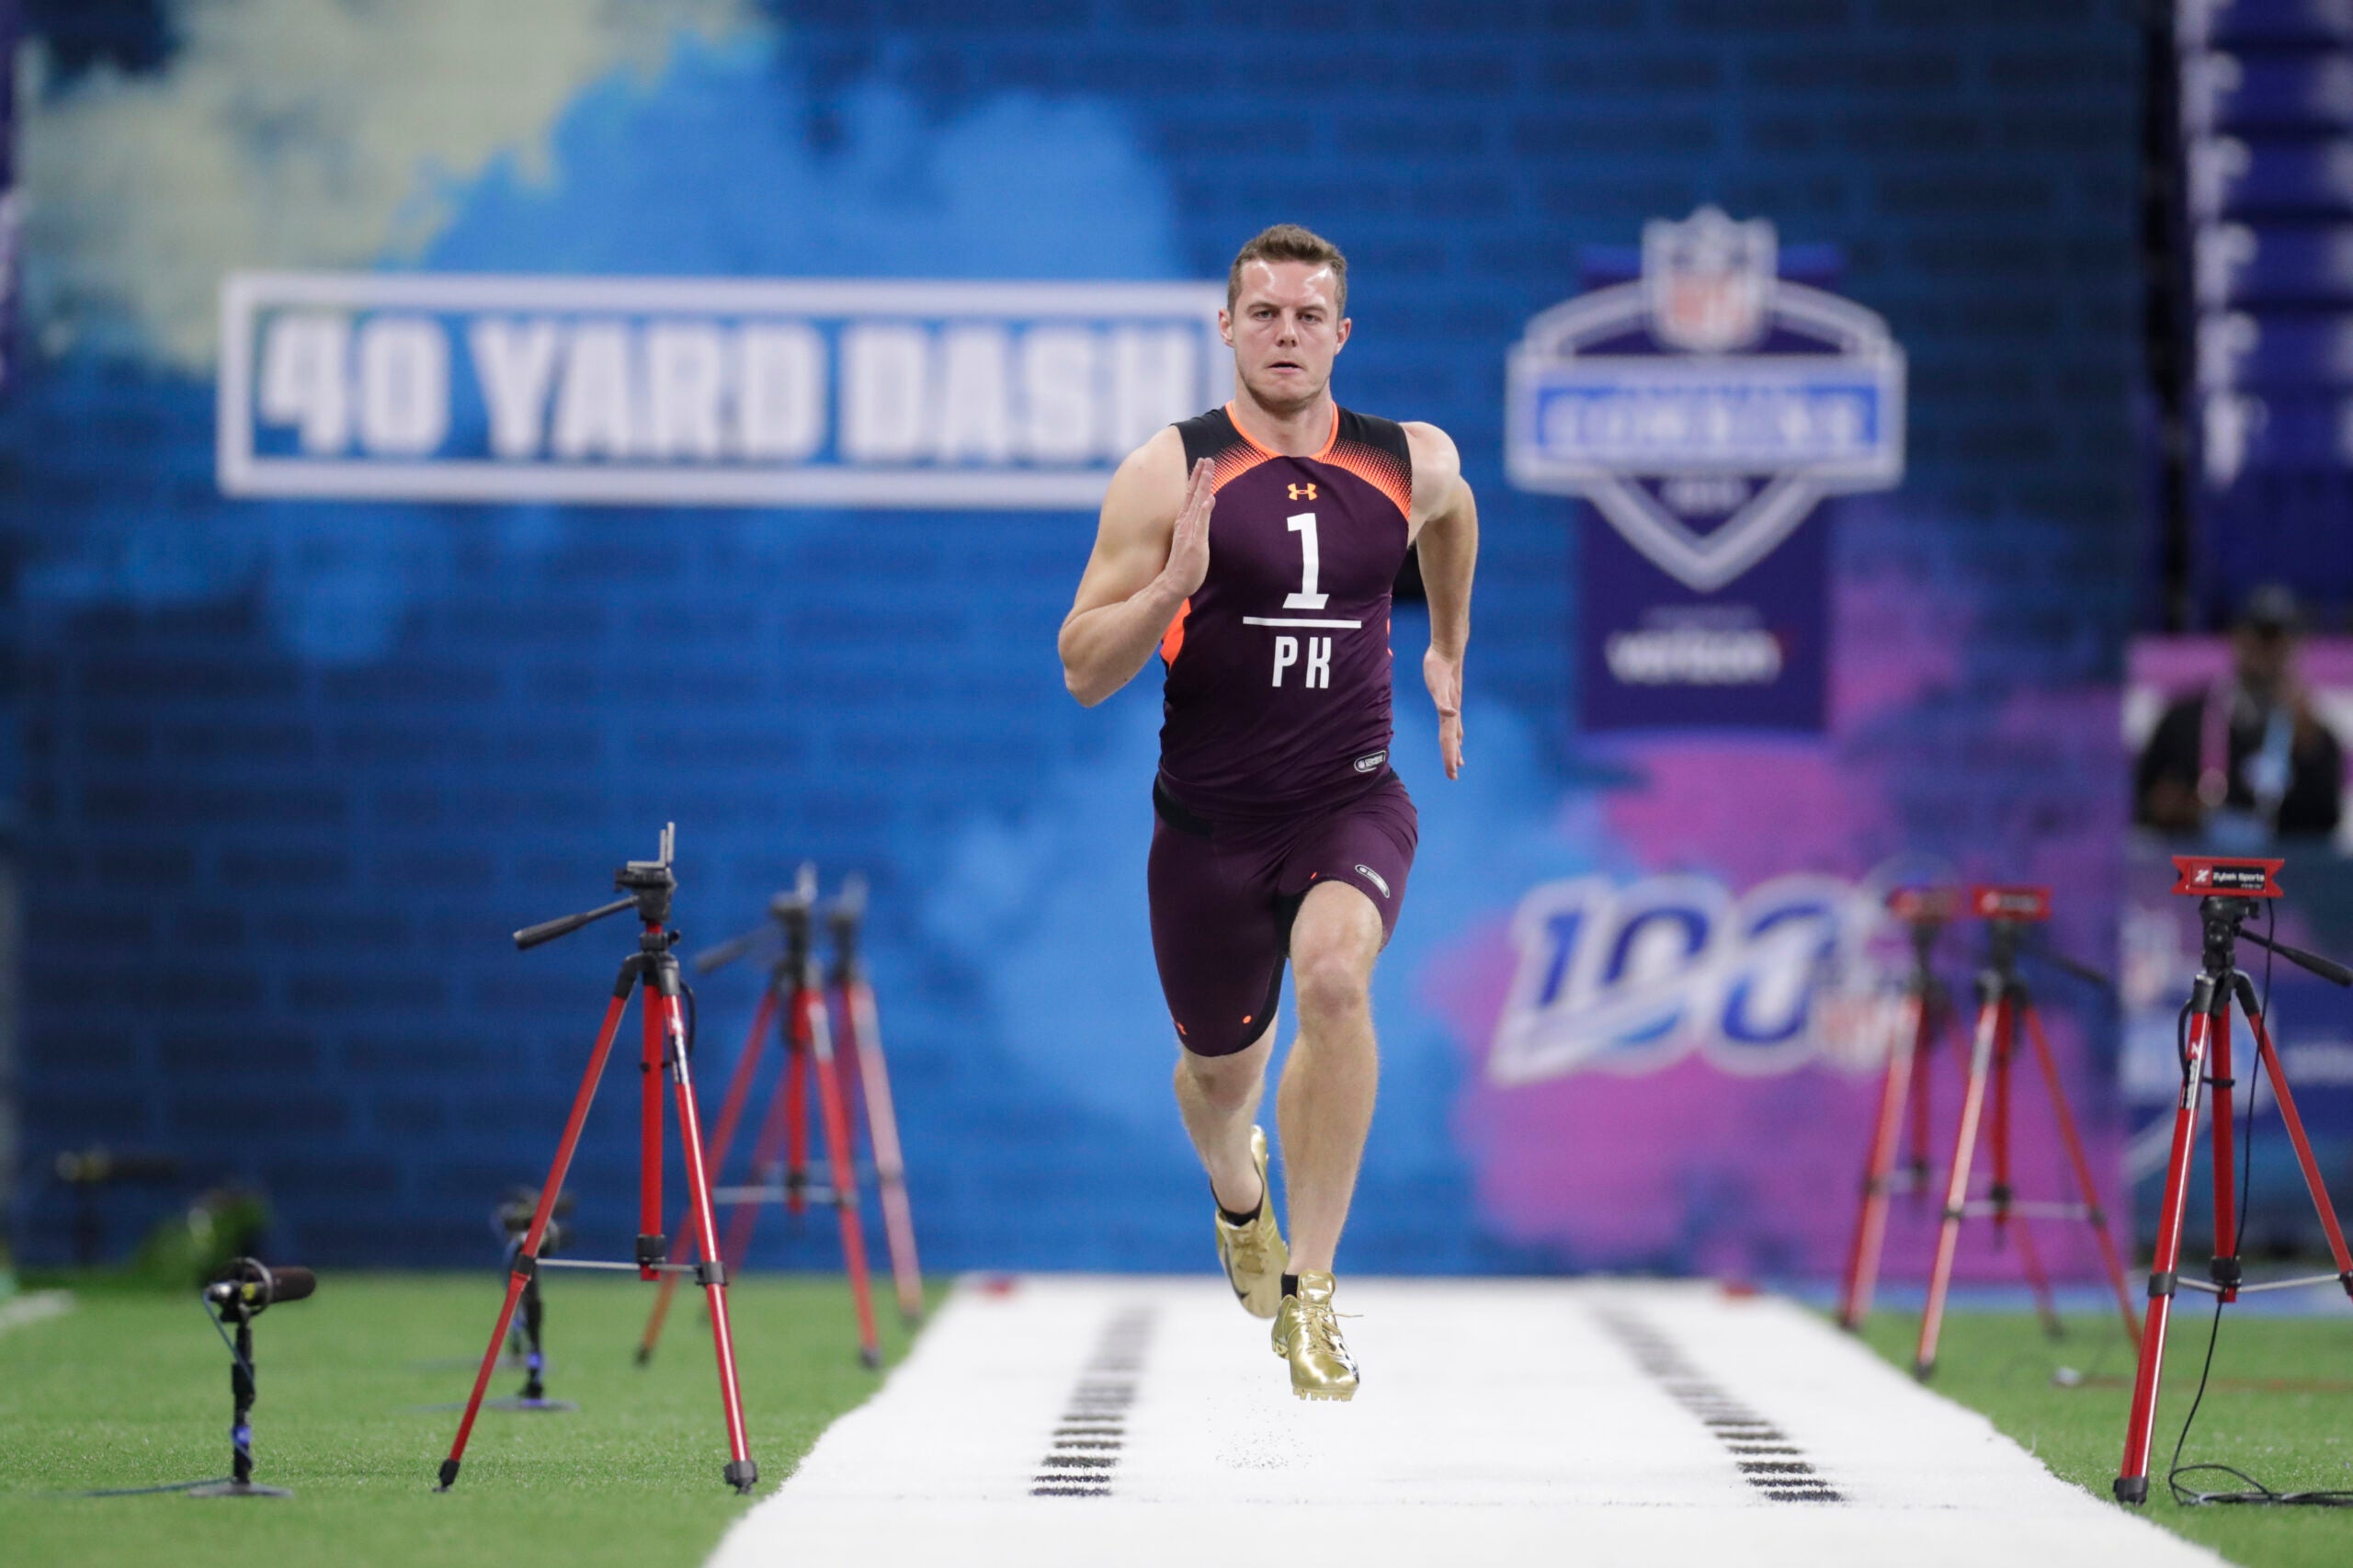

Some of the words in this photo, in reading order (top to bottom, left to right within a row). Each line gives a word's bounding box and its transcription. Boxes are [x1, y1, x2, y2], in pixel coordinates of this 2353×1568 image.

[262, 313, 449, 456] 40
[472, 317, 821, 459] YARD
[838, 322, 1197, 463] DASH
[1282, 512, 1330, 610] 1
[1272, 635, 1332, 689] PK
